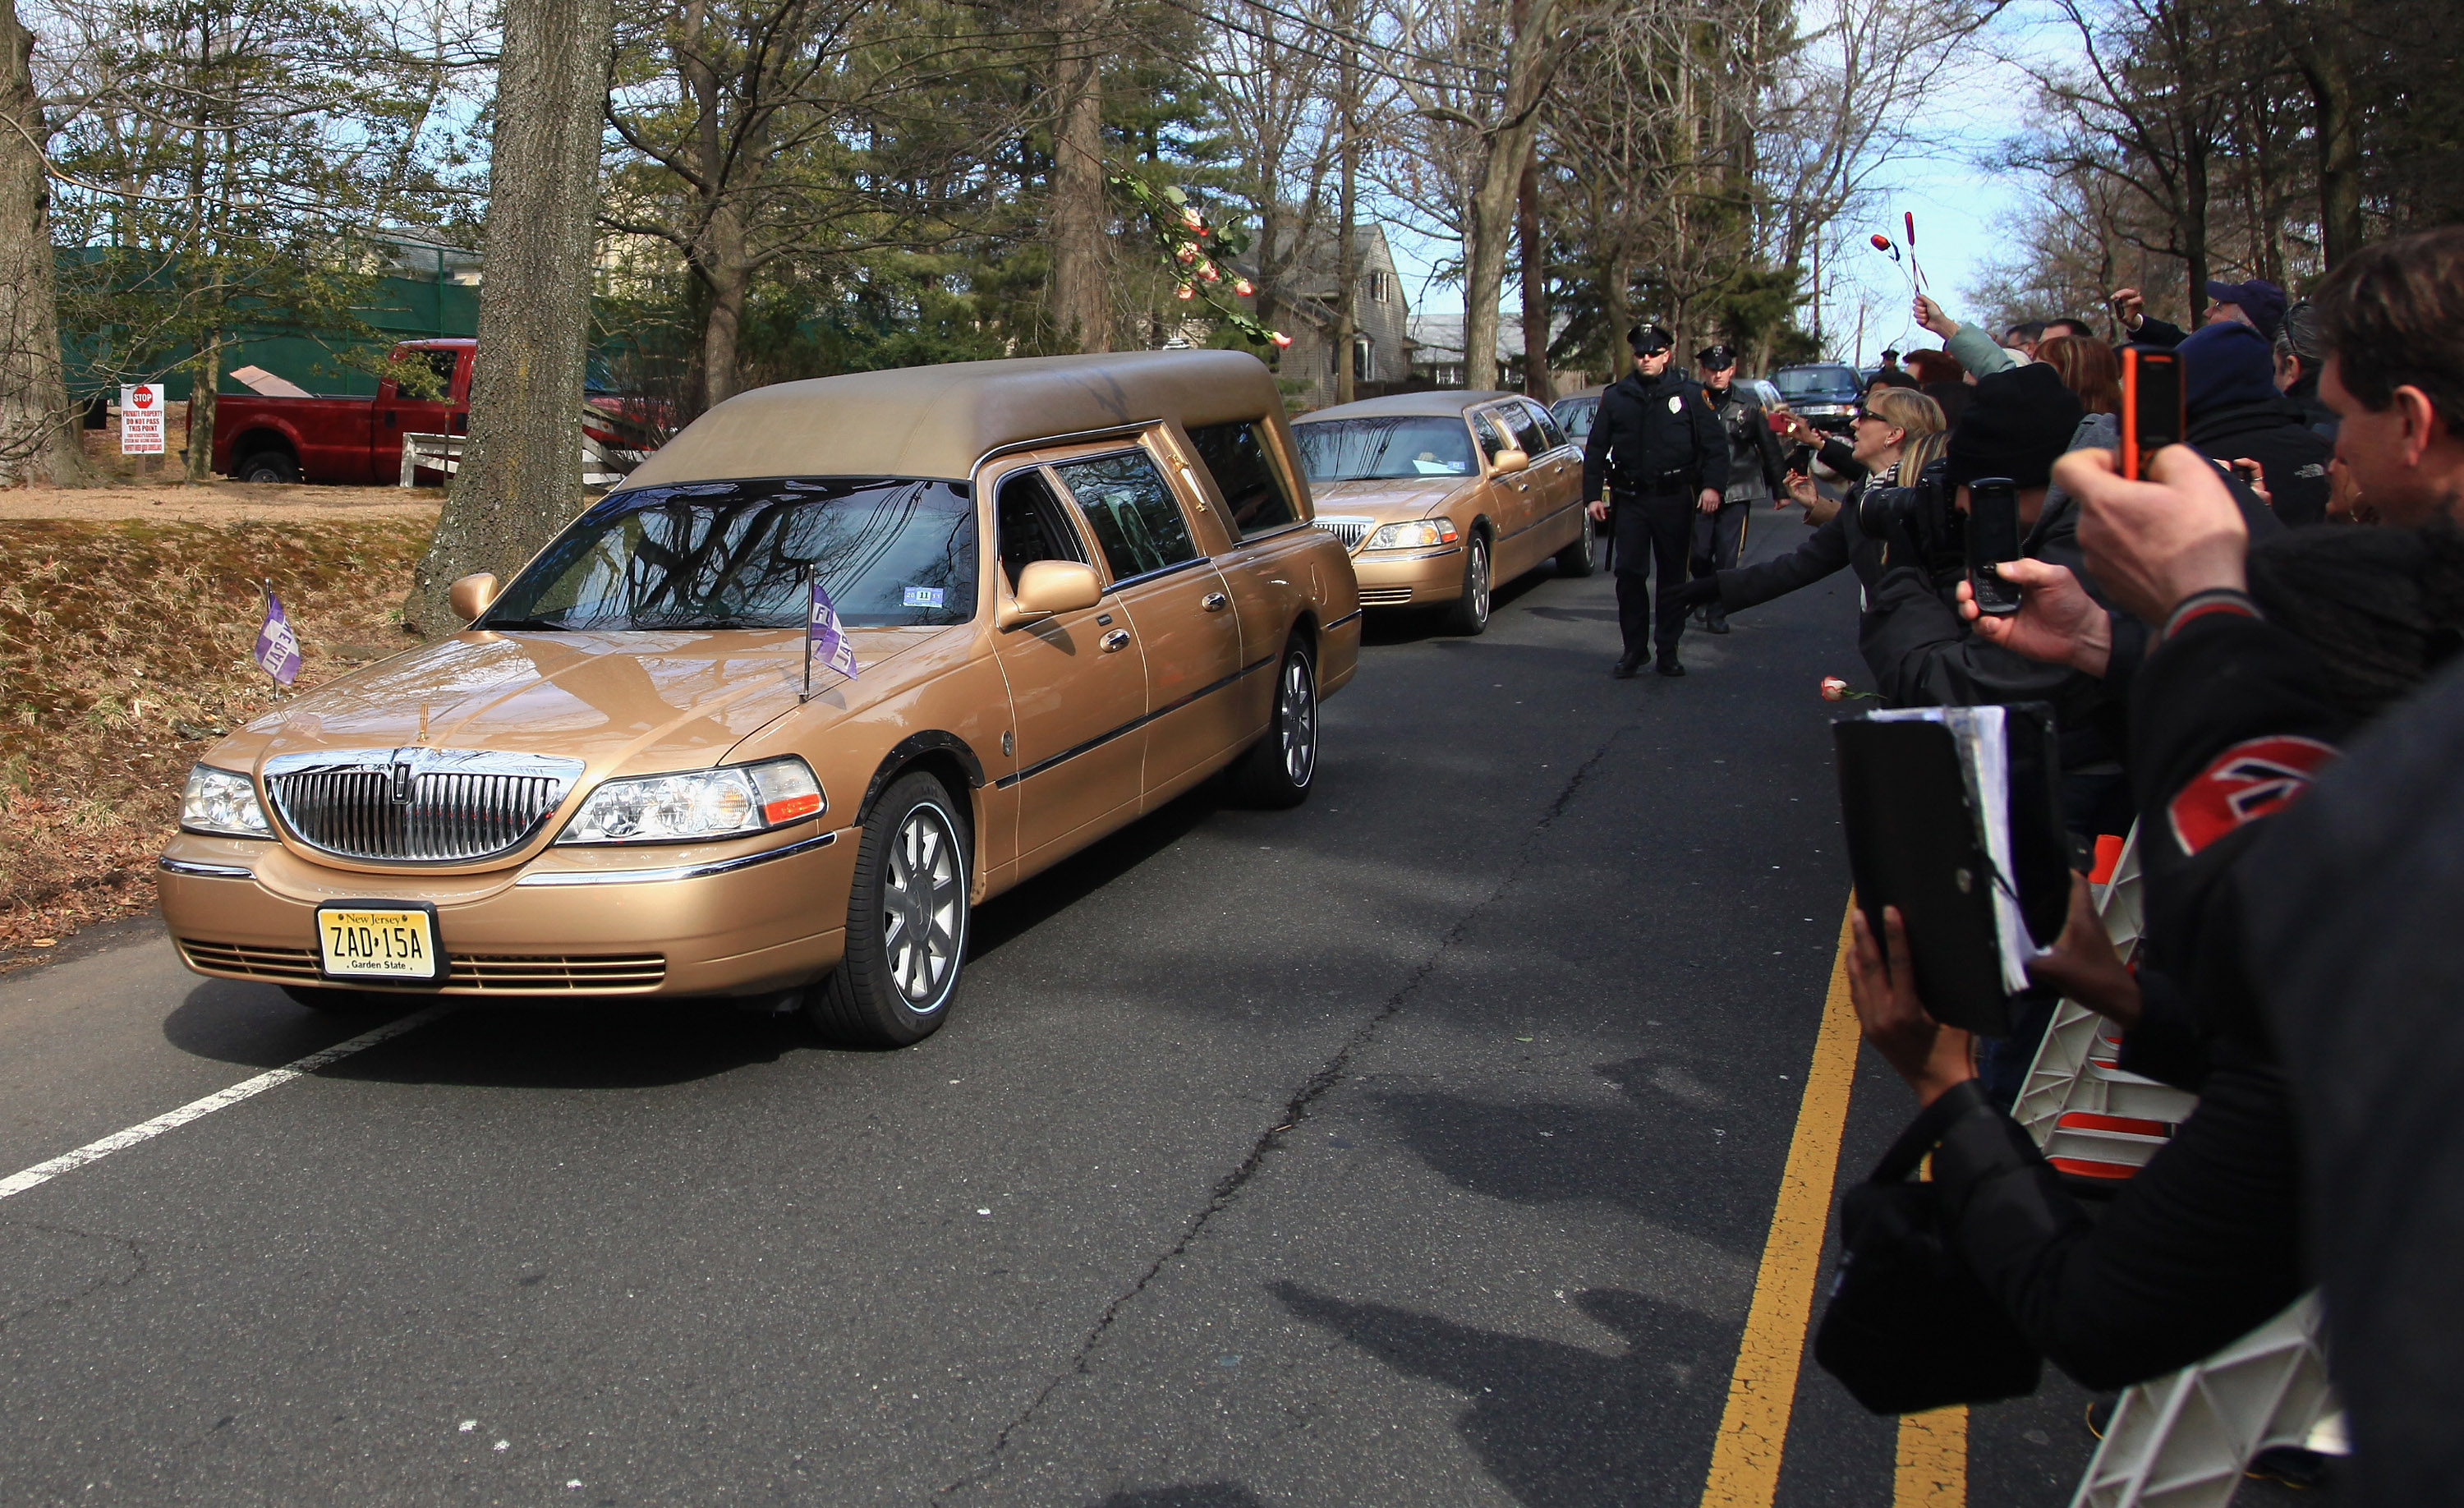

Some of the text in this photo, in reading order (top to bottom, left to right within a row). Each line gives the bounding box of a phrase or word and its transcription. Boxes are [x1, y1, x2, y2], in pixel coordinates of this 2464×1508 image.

[134, 393, 152, 402] STOP
[346, 913, 402, 926] New Jersey
[352, 959, 407, 970] Garden State
